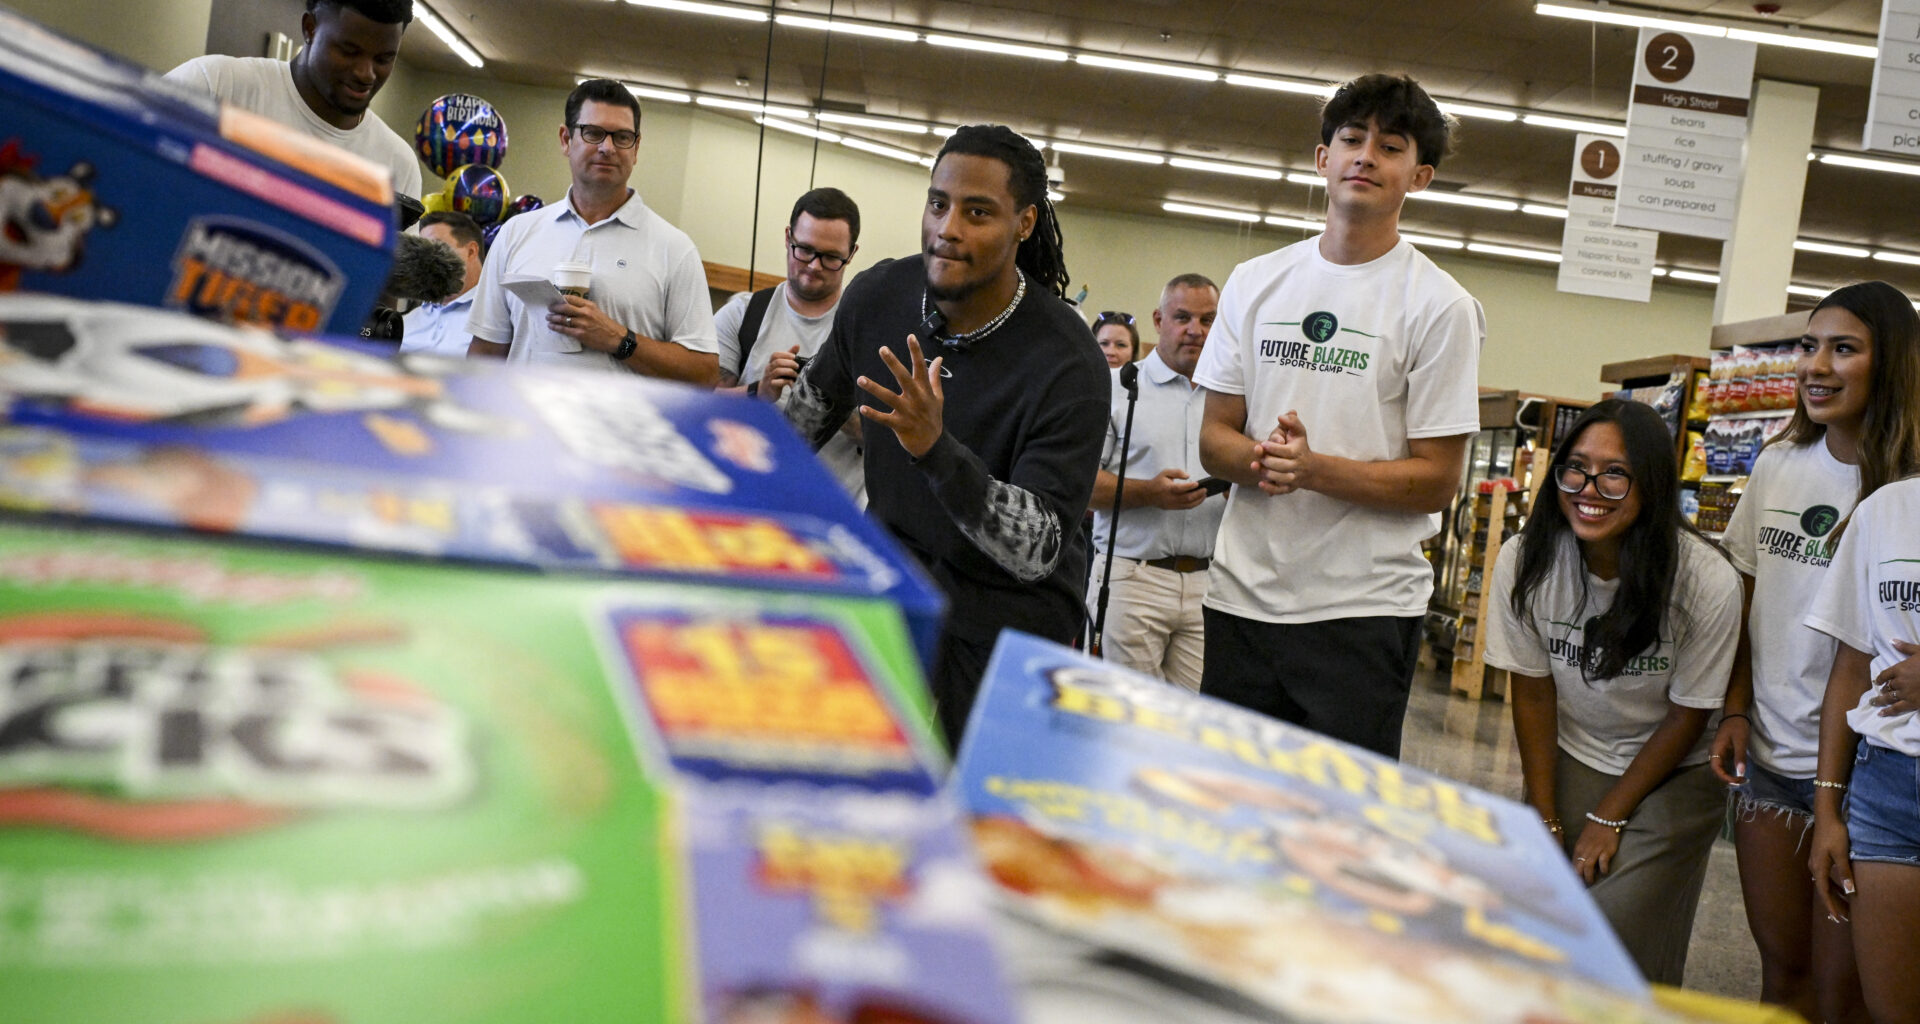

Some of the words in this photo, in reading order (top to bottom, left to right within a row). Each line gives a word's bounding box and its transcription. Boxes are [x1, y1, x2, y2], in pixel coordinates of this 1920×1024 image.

[1661, 46, 1679, 70] 2
[1662, 93, 1687, 108] High
[1689, 96, 1719, 110] Street
[447, 105, 499, 129] BIRTHDAY
[1671, 115, 1706, 129] beans
[1909, 109, 1920, 120] c
[1674, 136, 1696, 148] rice
[1598, 149, 1605, 169] 1
[1642, 152, 1681, 169] stuffing
[1683, 158, 1690, 168] /
[1692, 161, 1723, 174] gravy
[1664, 177, 1696, 190] soups
[1638, 194, 1660, 205] can
[1663, 197, 1716, 213] prepared
[1584, 235, 1610, 245] pasta
[1611, 239, 1639, 249] sauce
[1578, 249, 1613, 262] hispanic
[1616, 254, 1641, 265] foods
[1581, 267, 1617, 278] canned
[1619, 270, 1633, 280] fish
[360, 327, 371, 337] 25
[1260, 339, 1311, 361] FUTURE
[1312, 346, 1370, 370] BLAZERS
[1279, 358, 1317, 371] SPORTS
[1319, 363, 1343, 374] CAMP
[1759, 526, 1806, 554] FUTURE
[1805, 539, 1835, 559] BLA
[1768, 546, 1808, 564] SPORTS
[1879, 580, 1920, 603] FUTUR
